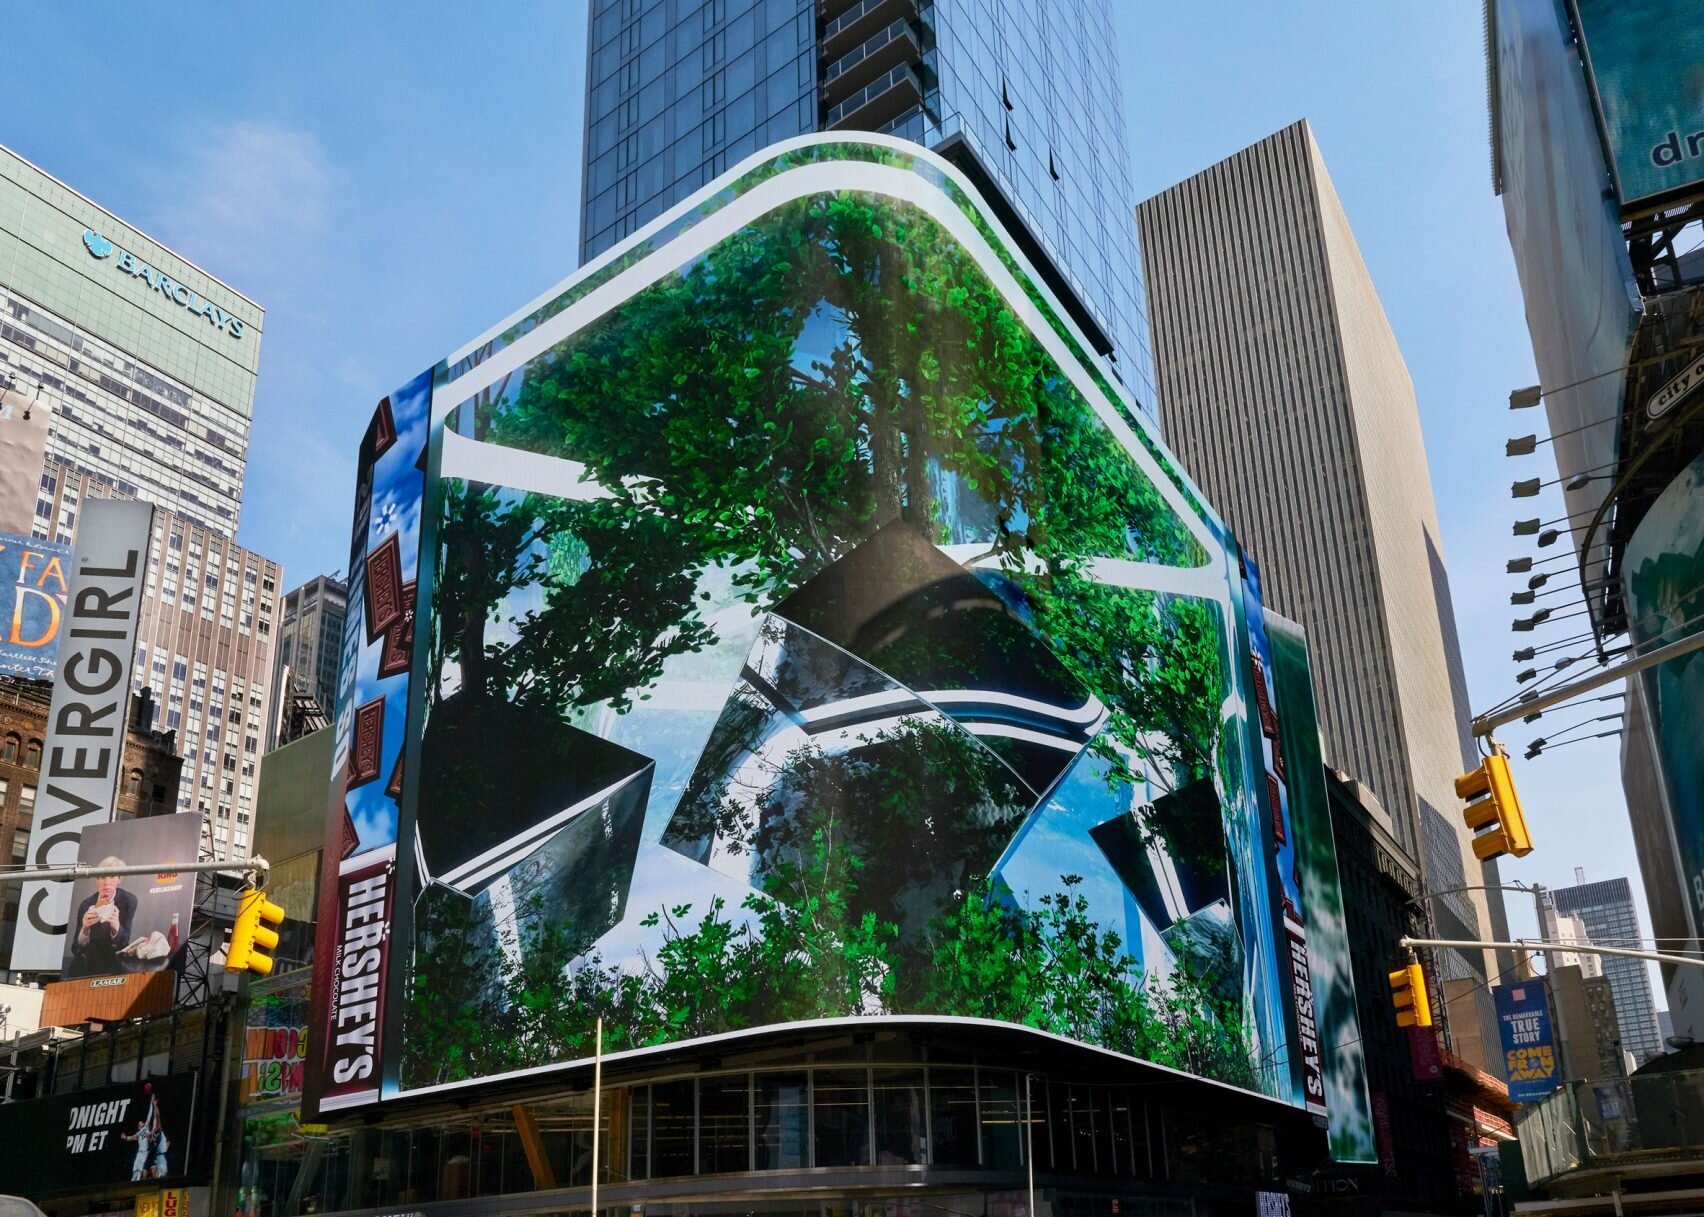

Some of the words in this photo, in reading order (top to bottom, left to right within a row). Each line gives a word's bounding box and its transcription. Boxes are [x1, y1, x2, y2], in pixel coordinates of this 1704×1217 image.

[117, 249, 245, 338] BARCLAYS
[1658, 374, 1690, 405] city
[329, 697, 354, 782] SQ
[335, 944, 343, 966] MILK
[92, 977, 123, 988] LAMAR
[333, 873, 387, 1085] HERSHEY'S
[330, 966, 342, 1021] CHOCOLATE
[1290, 940, 1323, 1098] HERSHEY'S
[1510, 1017, 1541, 1033] TRUE
[1512, 1010, 1543, 1020] REMARKABLE
[1513, 1031, 1541, 1044] STORY
[1506, 1045, 1552, 1061] COME
[1507, 1056, 1556, 1072] FROM
[1509, 1068, 1555, 1082] AWAY
[68, 1098, 131, 1131] ONIGHT
[66, 1133, 87, 1154] PM
[88, 1130, 109, 1152] ET
